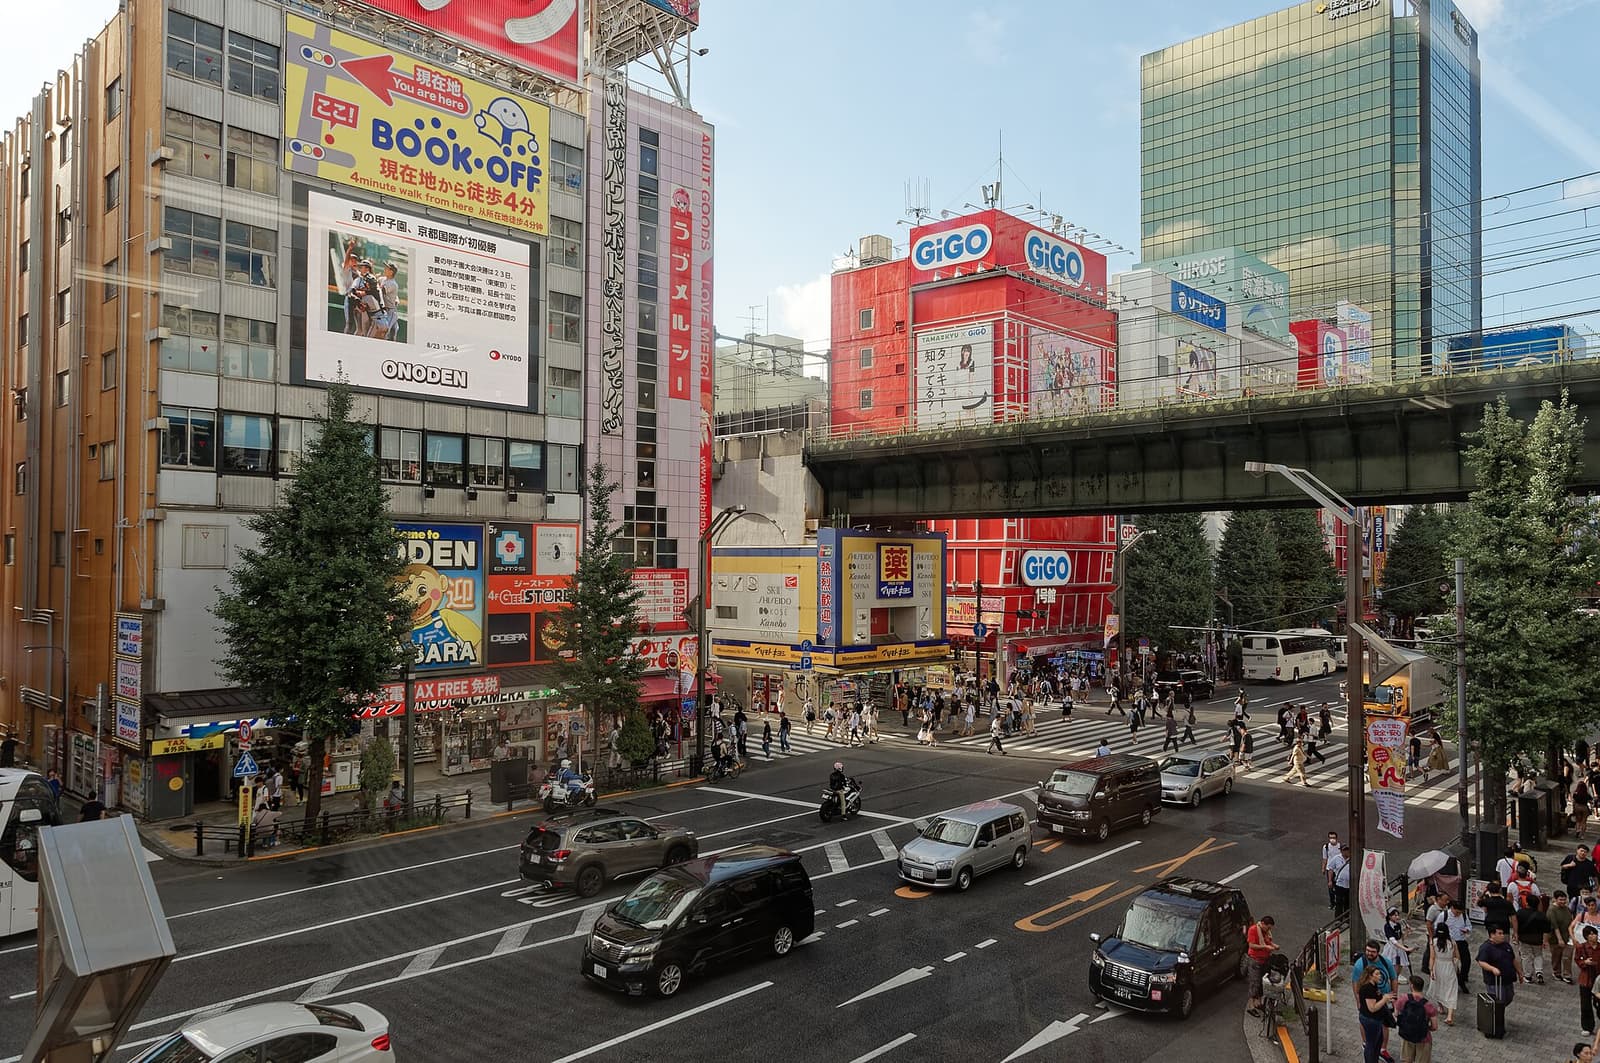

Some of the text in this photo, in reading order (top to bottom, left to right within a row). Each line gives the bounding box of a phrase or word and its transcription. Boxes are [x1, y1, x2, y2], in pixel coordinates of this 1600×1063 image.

[393, 77, 464, 110] You are here
[415, 67, 461, 97] 現在地
[316, 97, 354, 123] ここ!
[350, 171, 474, 214] 4minute walk from here
[379, 157, 536, 217] 現在地から徒歩4分
[351, 208, 497, 254] 夏の甲子園、京都国際が初優勝
[702, 188, 711, 250] GOODS
[915, 228, 988, 266] GiGO
[1027, 235, 1082, 282] GiGO
[1179, 256, 1226, 281] HIROSE
[671, 221, 690, 391] ラブメルシー
[700, 280, 711, 380] LOVE MERCI
[968, 328, 987, 337] GiGO
[502, 353, 522, 363] KYODO
[381, 359, 468, 388] ONODEN
[426, 528, 440, 540] to
[885, 547, 908, 580] 薬
[1025, 556, 1069, 581] GiGO
[488, 590, 499, 601] 4F
[514, 579, 553, 587] シーストア
[758, 597, 792, 606] SHISEIDO
[759, 618, 787, 628] Kanebo
[491, 633, 527, 642] COSPA
[414, 680, 469, 699] AX FREE
[471, 676, 499, 695] 免税
[121, 704, 137, 717] SONY
[120, 726, 138, 739] SHARP
[167, 739, 186, 747] TAX
